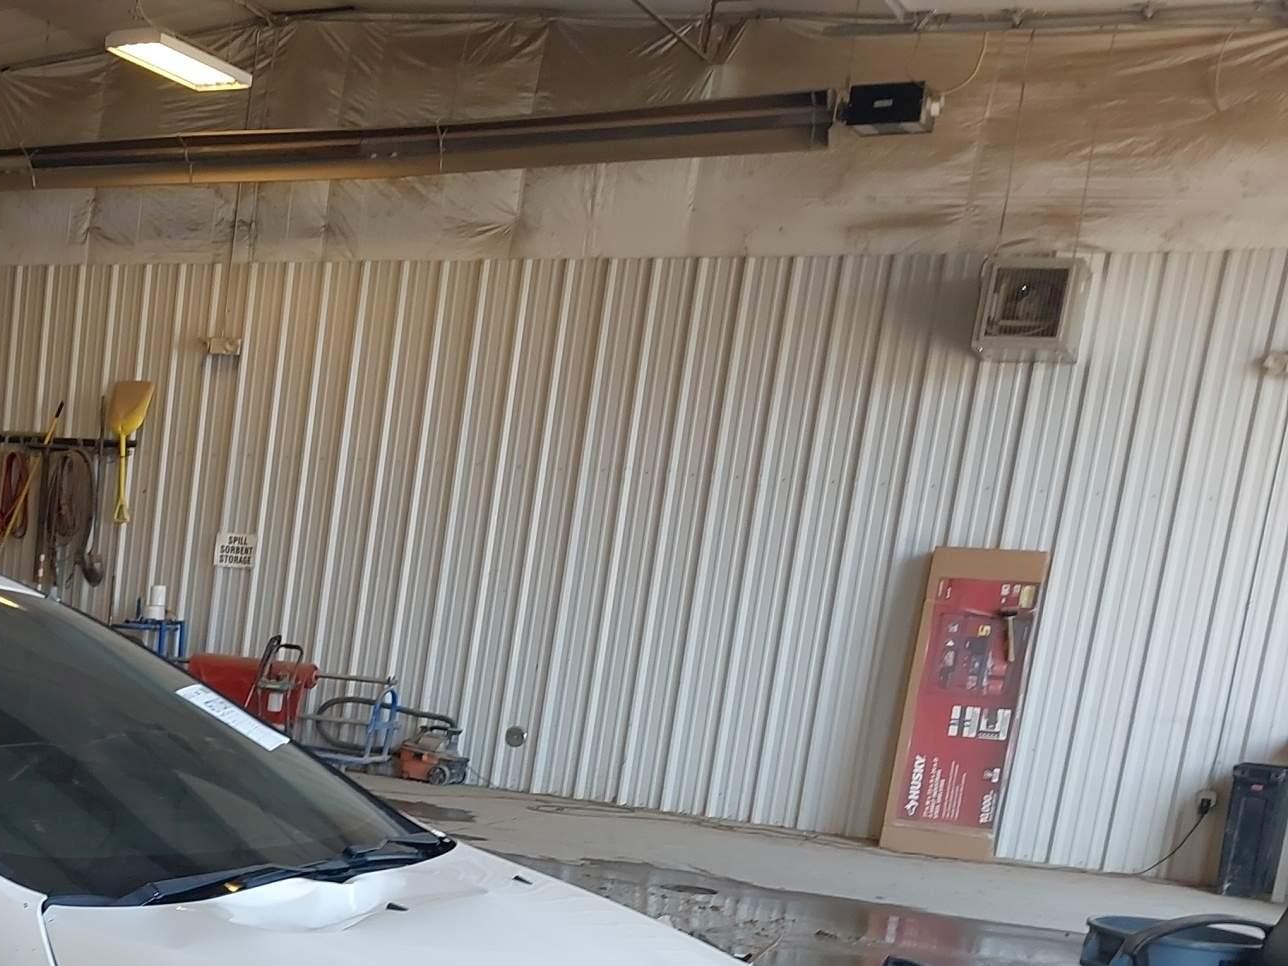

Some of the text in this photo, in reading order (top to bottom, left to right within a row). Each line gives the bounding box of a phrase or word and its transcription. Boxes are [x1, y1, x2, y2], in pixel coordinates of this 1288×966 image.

[228, 535, 247, 545] SPILL
[220, 544, 253, 555] SORBENT
[219, 554, 251, 565] STORAGE
[908, 755, 926, 800] HUSKY
